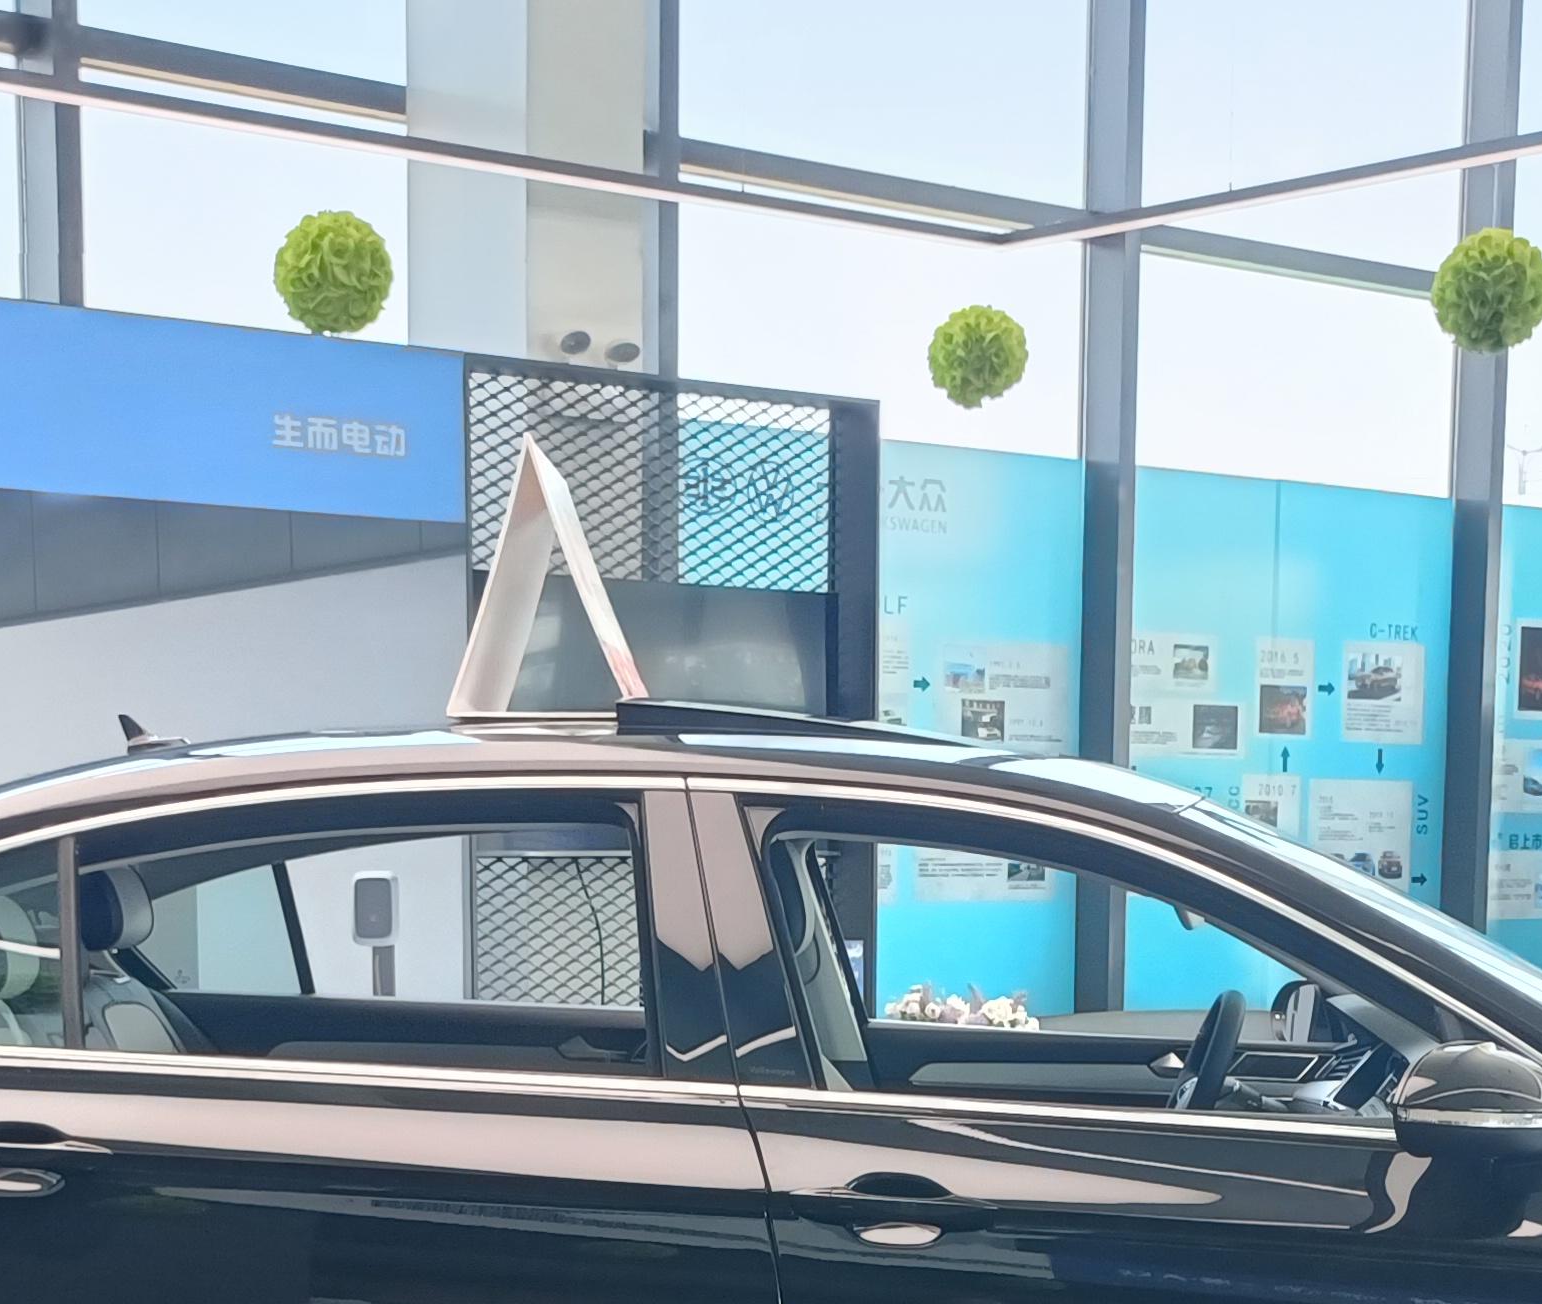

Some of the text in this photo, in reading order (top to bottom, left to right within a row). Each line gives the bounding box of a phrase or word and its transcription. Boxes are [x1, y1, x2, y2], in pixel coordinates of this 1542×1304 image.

[272, 414, 406, 457] 生而电动
[1369, 622, 1419, 641] C-TREK
[1416, 794, 1429, 836] SUV
